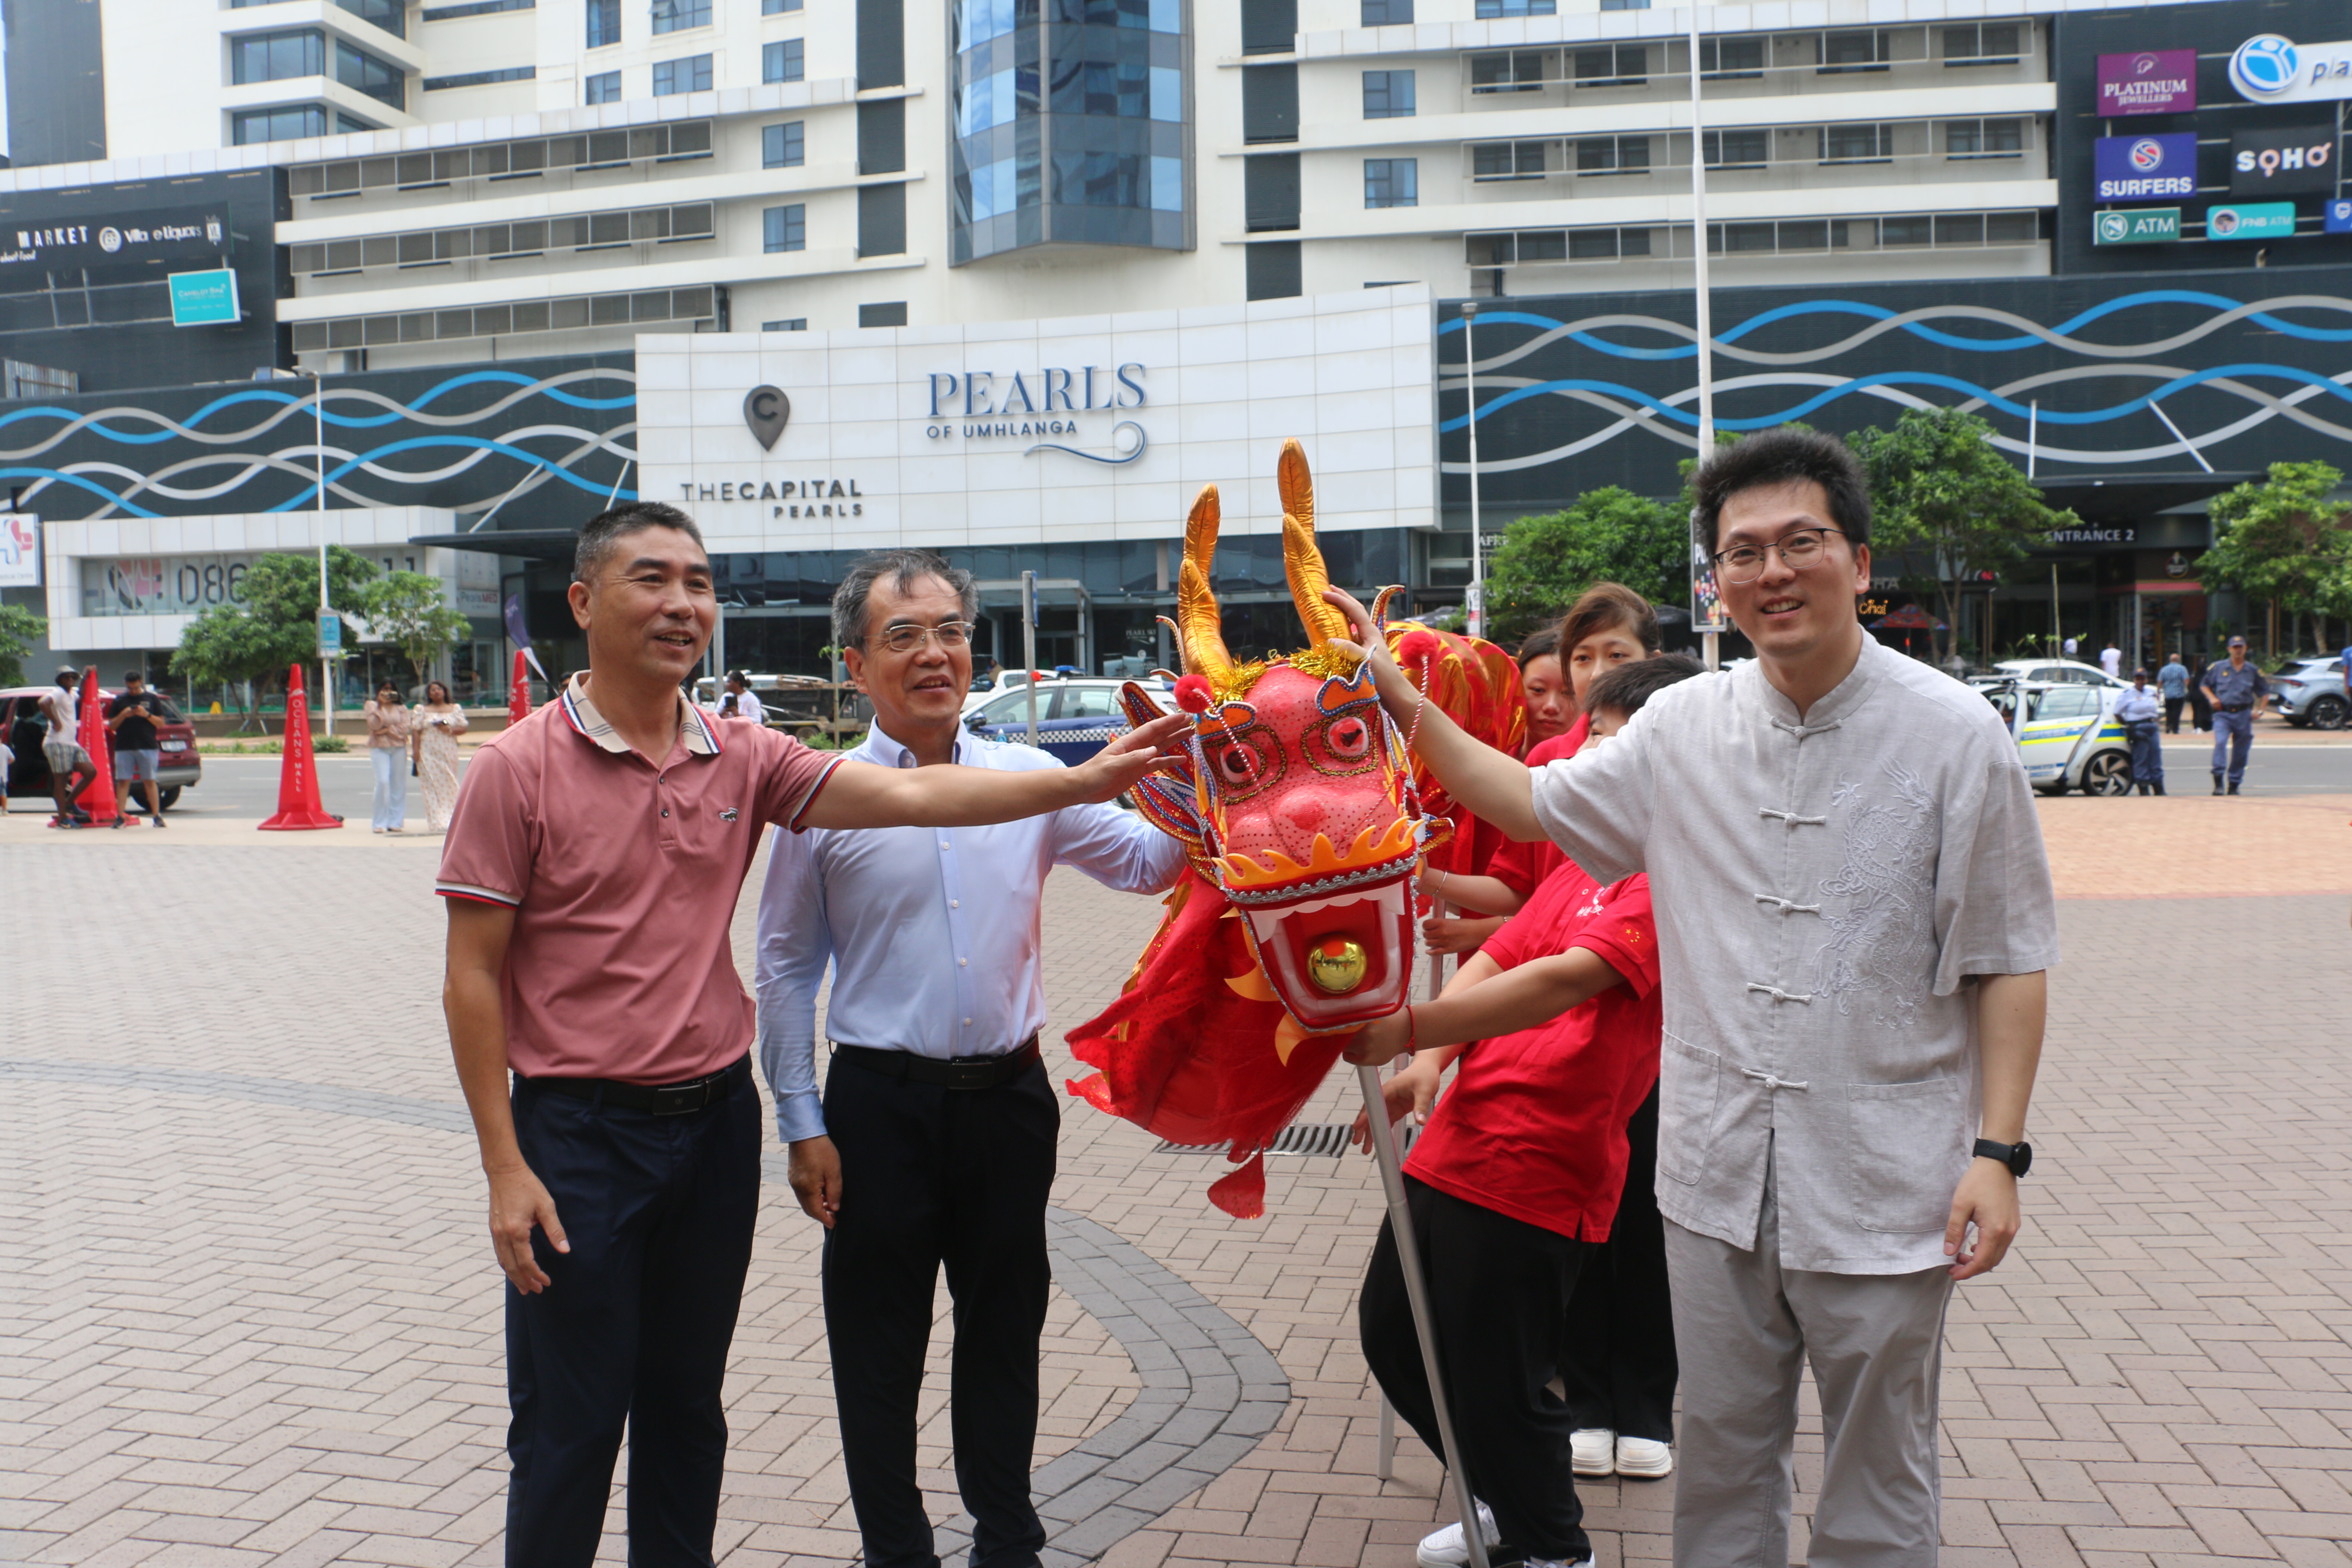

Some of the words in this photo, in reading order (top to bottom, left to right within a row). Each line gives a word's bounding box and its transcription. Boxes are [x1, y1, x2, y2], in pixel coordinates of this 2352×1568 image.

[2104, 79, 2187, 98] PLATINUM
[2118, 93, 2173, 107] JEWELLERS
[2236, 142, 2331, 177] SOHO
[2100, 177, 2193, 197] SURFERS
[2133, 217, 2175, 235] ATM
[2242, 217, 2267, 227] FNB
[2270, 216, 2292, 225] ATM
[17, 225, 88, 248] MARKET
[927, 362, 1148, 418] PEARLS
[927, 425, 951, 438] OF
[963, 420, 1077, 438] UMHLANGA
[774, 503, 862, 518] PEARLS
[2126, 529, 2135, 541] 2
[292, 699, 302, 758] OCEANS
[294, 763, 303, 792] MALL
